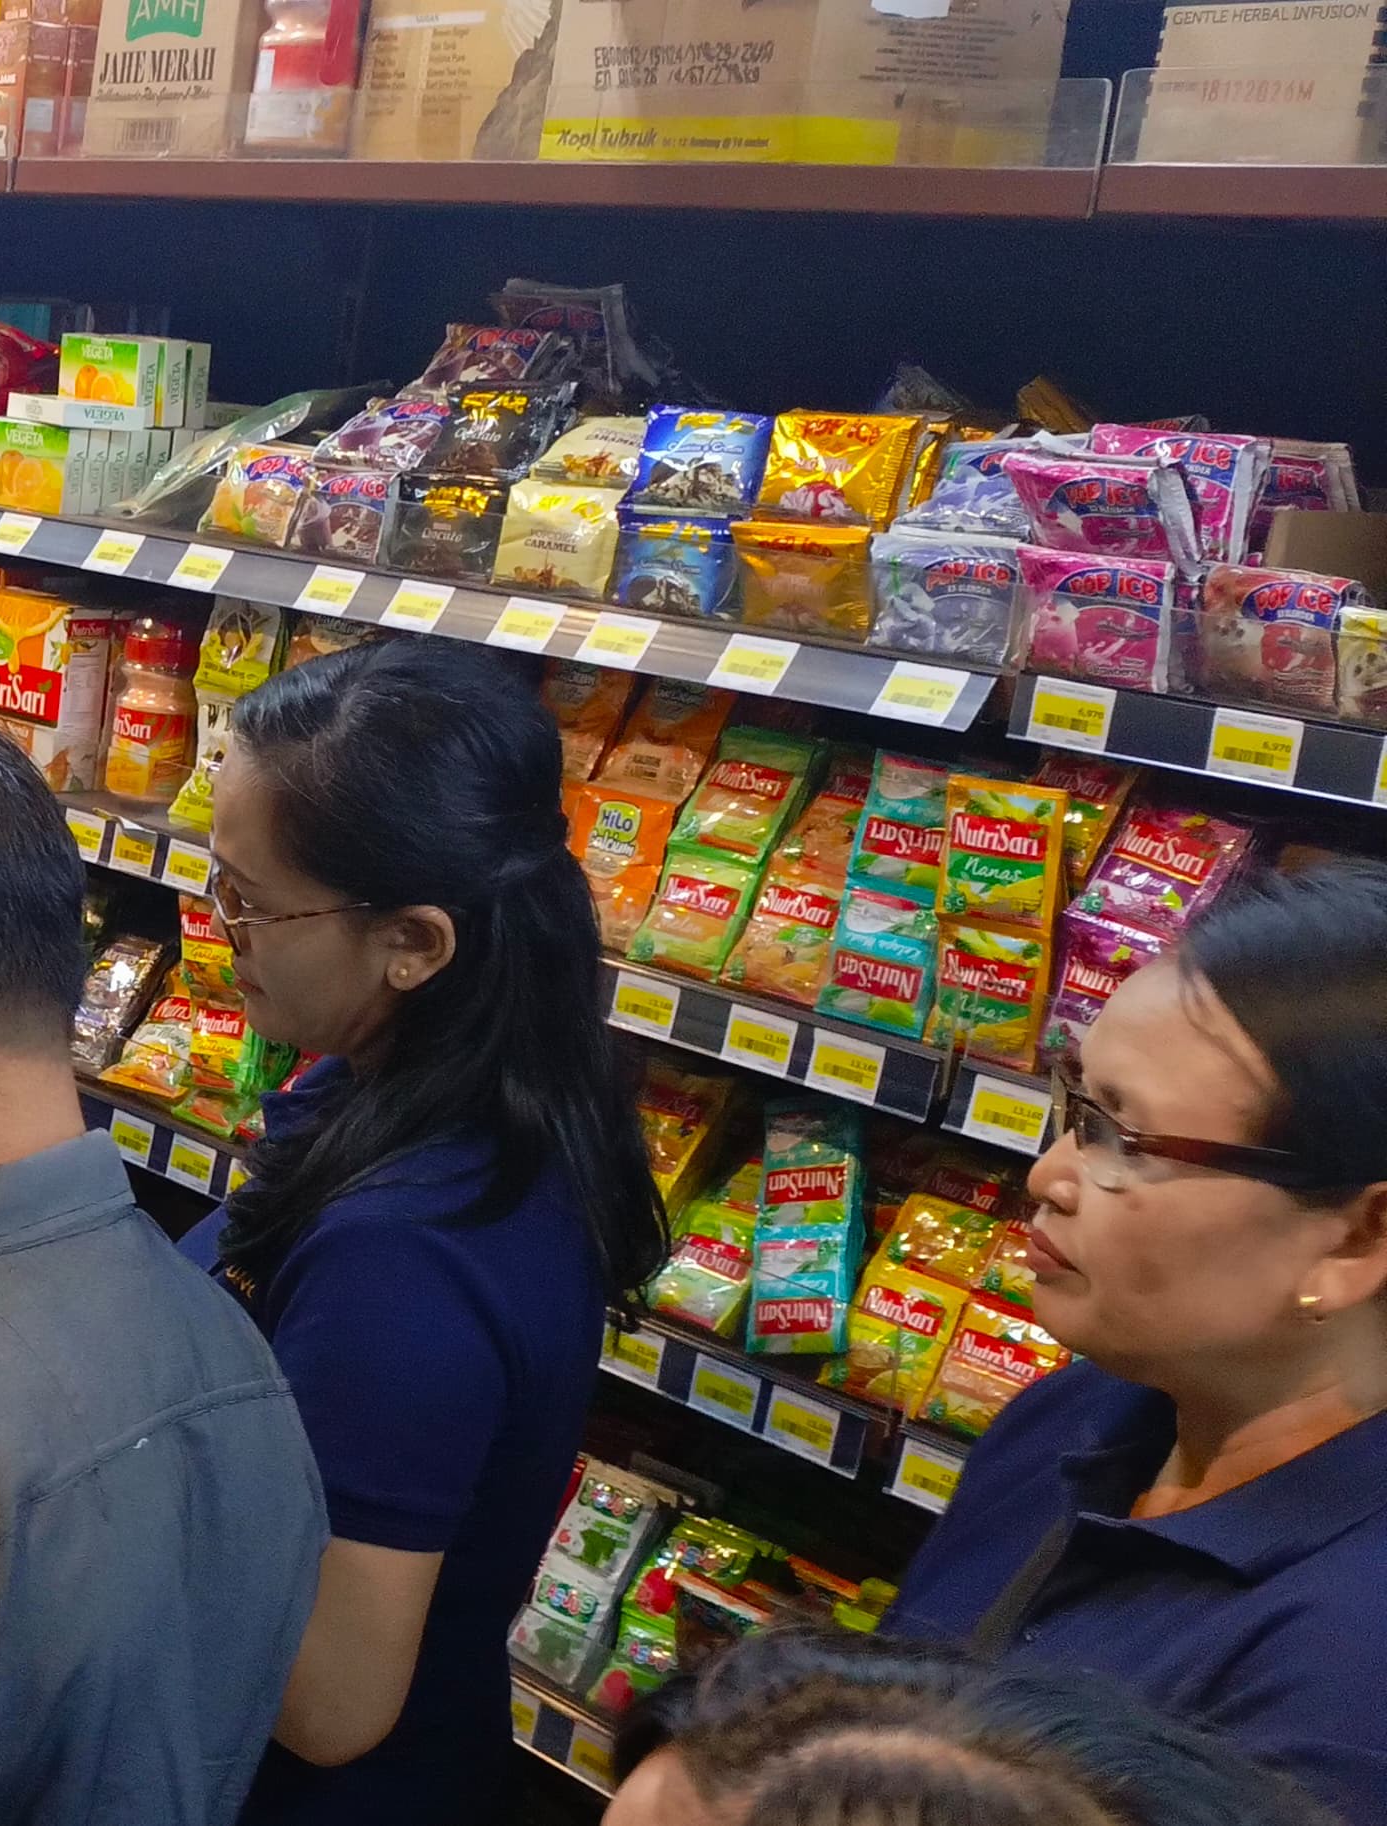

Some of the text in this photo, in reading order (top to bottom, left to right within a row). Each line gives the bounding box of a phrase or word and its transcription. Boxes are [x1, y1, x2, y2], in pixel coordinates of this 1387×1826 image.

[1172, 4, 1371, 25] GENTLE HERBAL INFUSION
[99, 47, 216, 84] JAHE MERAH
[1077, 708, 1105, 720] 6,970
[1262, 741, 1292, 753] 6,970
[713, 763, 783, 796] NutriSari
[954, 816, 1040, 857] NutriSari
[1120, 822, 1206, 876] NutriSari
[964, 857, 1023, 884] Nanas
[665, 874, 730, 915] NutriSari
[764, 886, 833, 925] NutriSari
[837, 957, 917, 1000] NutriSari
[947, 952, 1027, 999] NutriSari
[1012, 1105, 1044, 1121] 13,160
[864, 1287, 936, 1334] NutriSari
